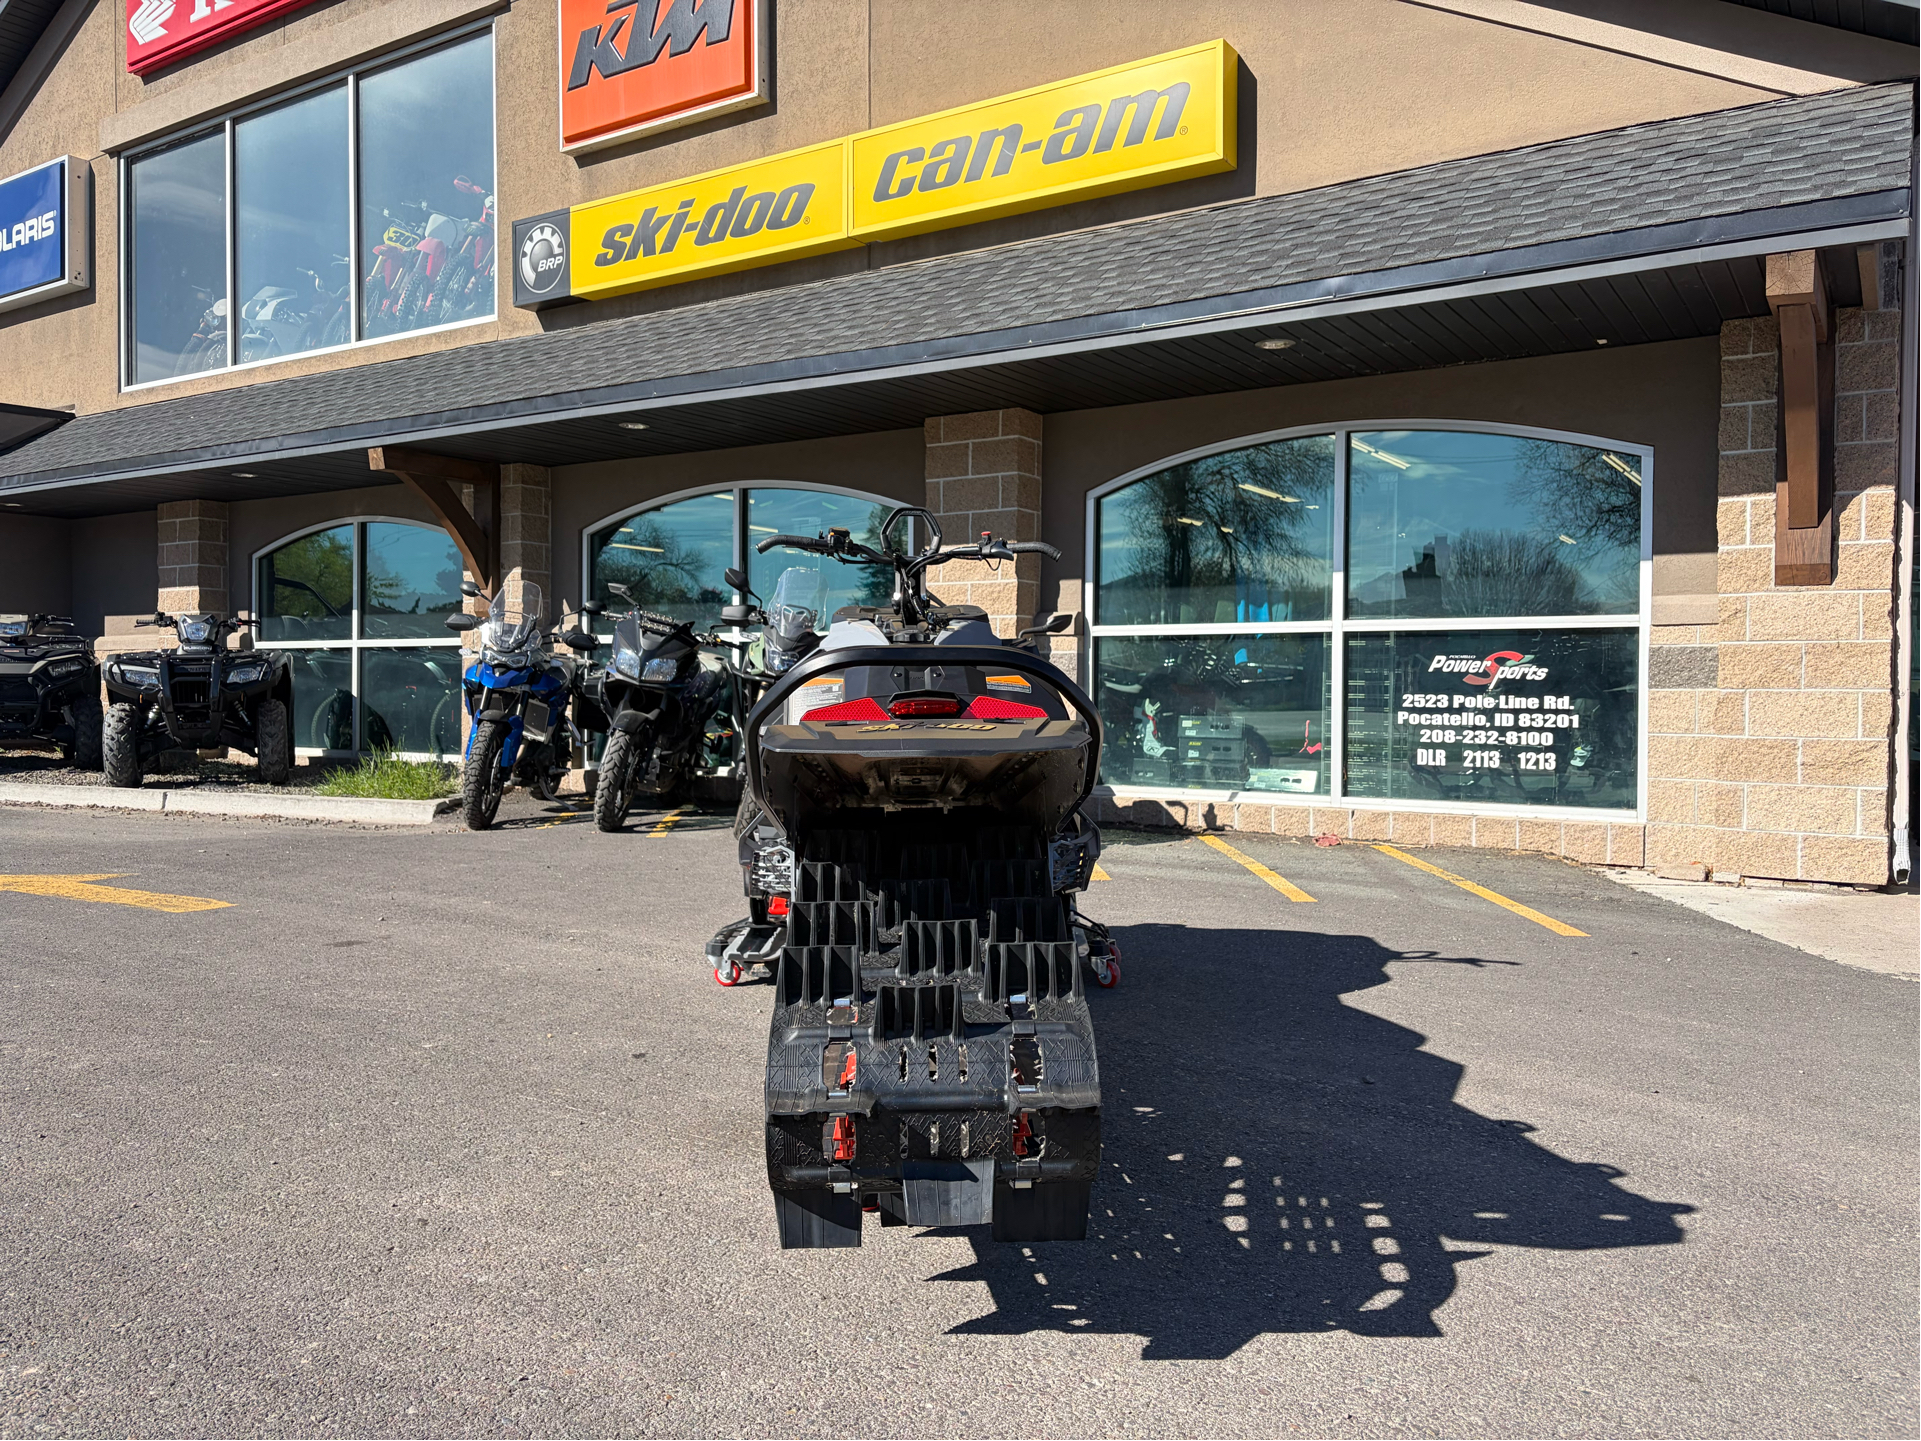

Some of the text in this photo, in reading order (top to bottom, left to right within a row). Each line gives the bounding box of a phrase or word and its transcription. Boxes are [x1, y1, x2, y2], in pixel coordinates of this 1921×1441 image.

[567, 0, 735, 92] KTM
[873, 81, 1191, 203] can-am
[0, 210, 55, 253] LARIS
[594, 182, 816, 268] ski-doo
[537, 254, 564, 272] BRP
[1402, 694, 1575, 710] 2523 Pole Line Rd.
[1397, 711, 1580, 728] Pocatello, ID 83201
[1419, 729, 1554, 746] 208-232-8100
[1416, 748, 1557, 770] DLR 2113 1213
